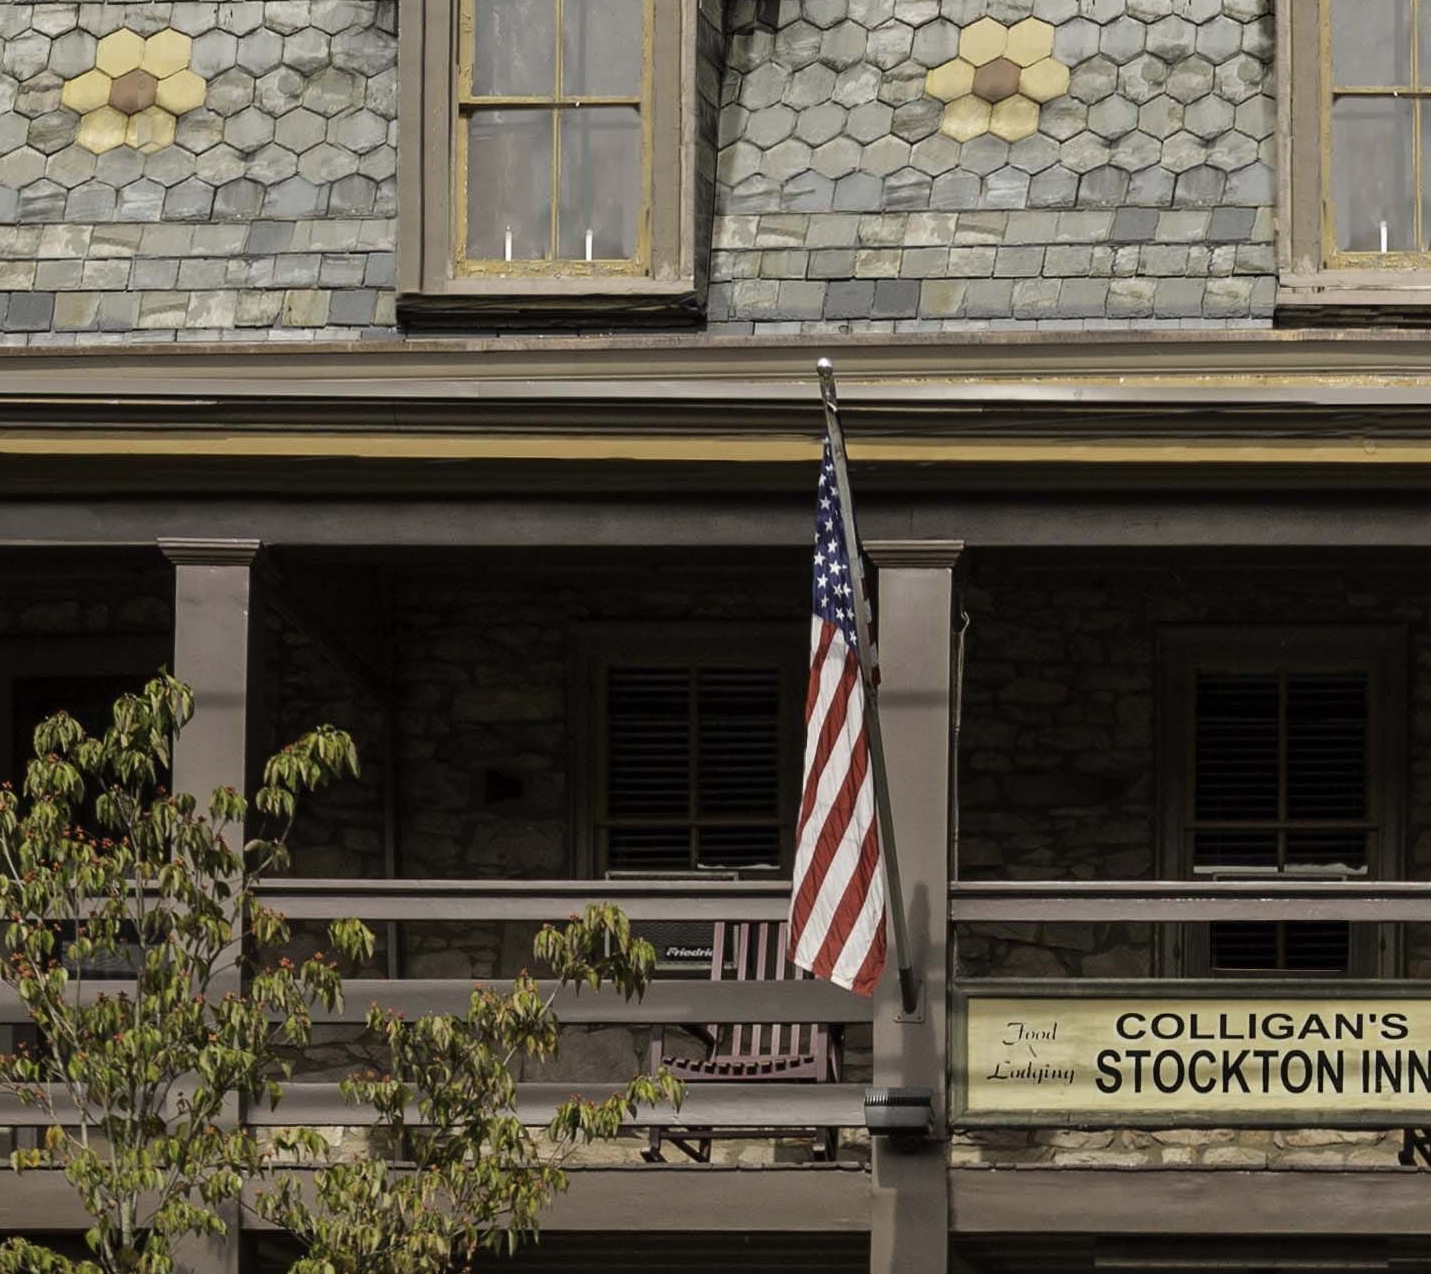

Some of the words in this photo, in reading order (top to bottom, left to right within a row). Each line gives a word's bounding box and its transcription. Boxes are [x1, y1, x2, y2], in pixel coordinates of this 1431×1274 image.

[1002, 1021, 1057, 1046] Food
[1116, 1012, 1409, 1040] COLLIGAN'S
[986, 1060, 1075, 1085] Lodging
[1095, 1049, 1344, 1094] STOCKTON
